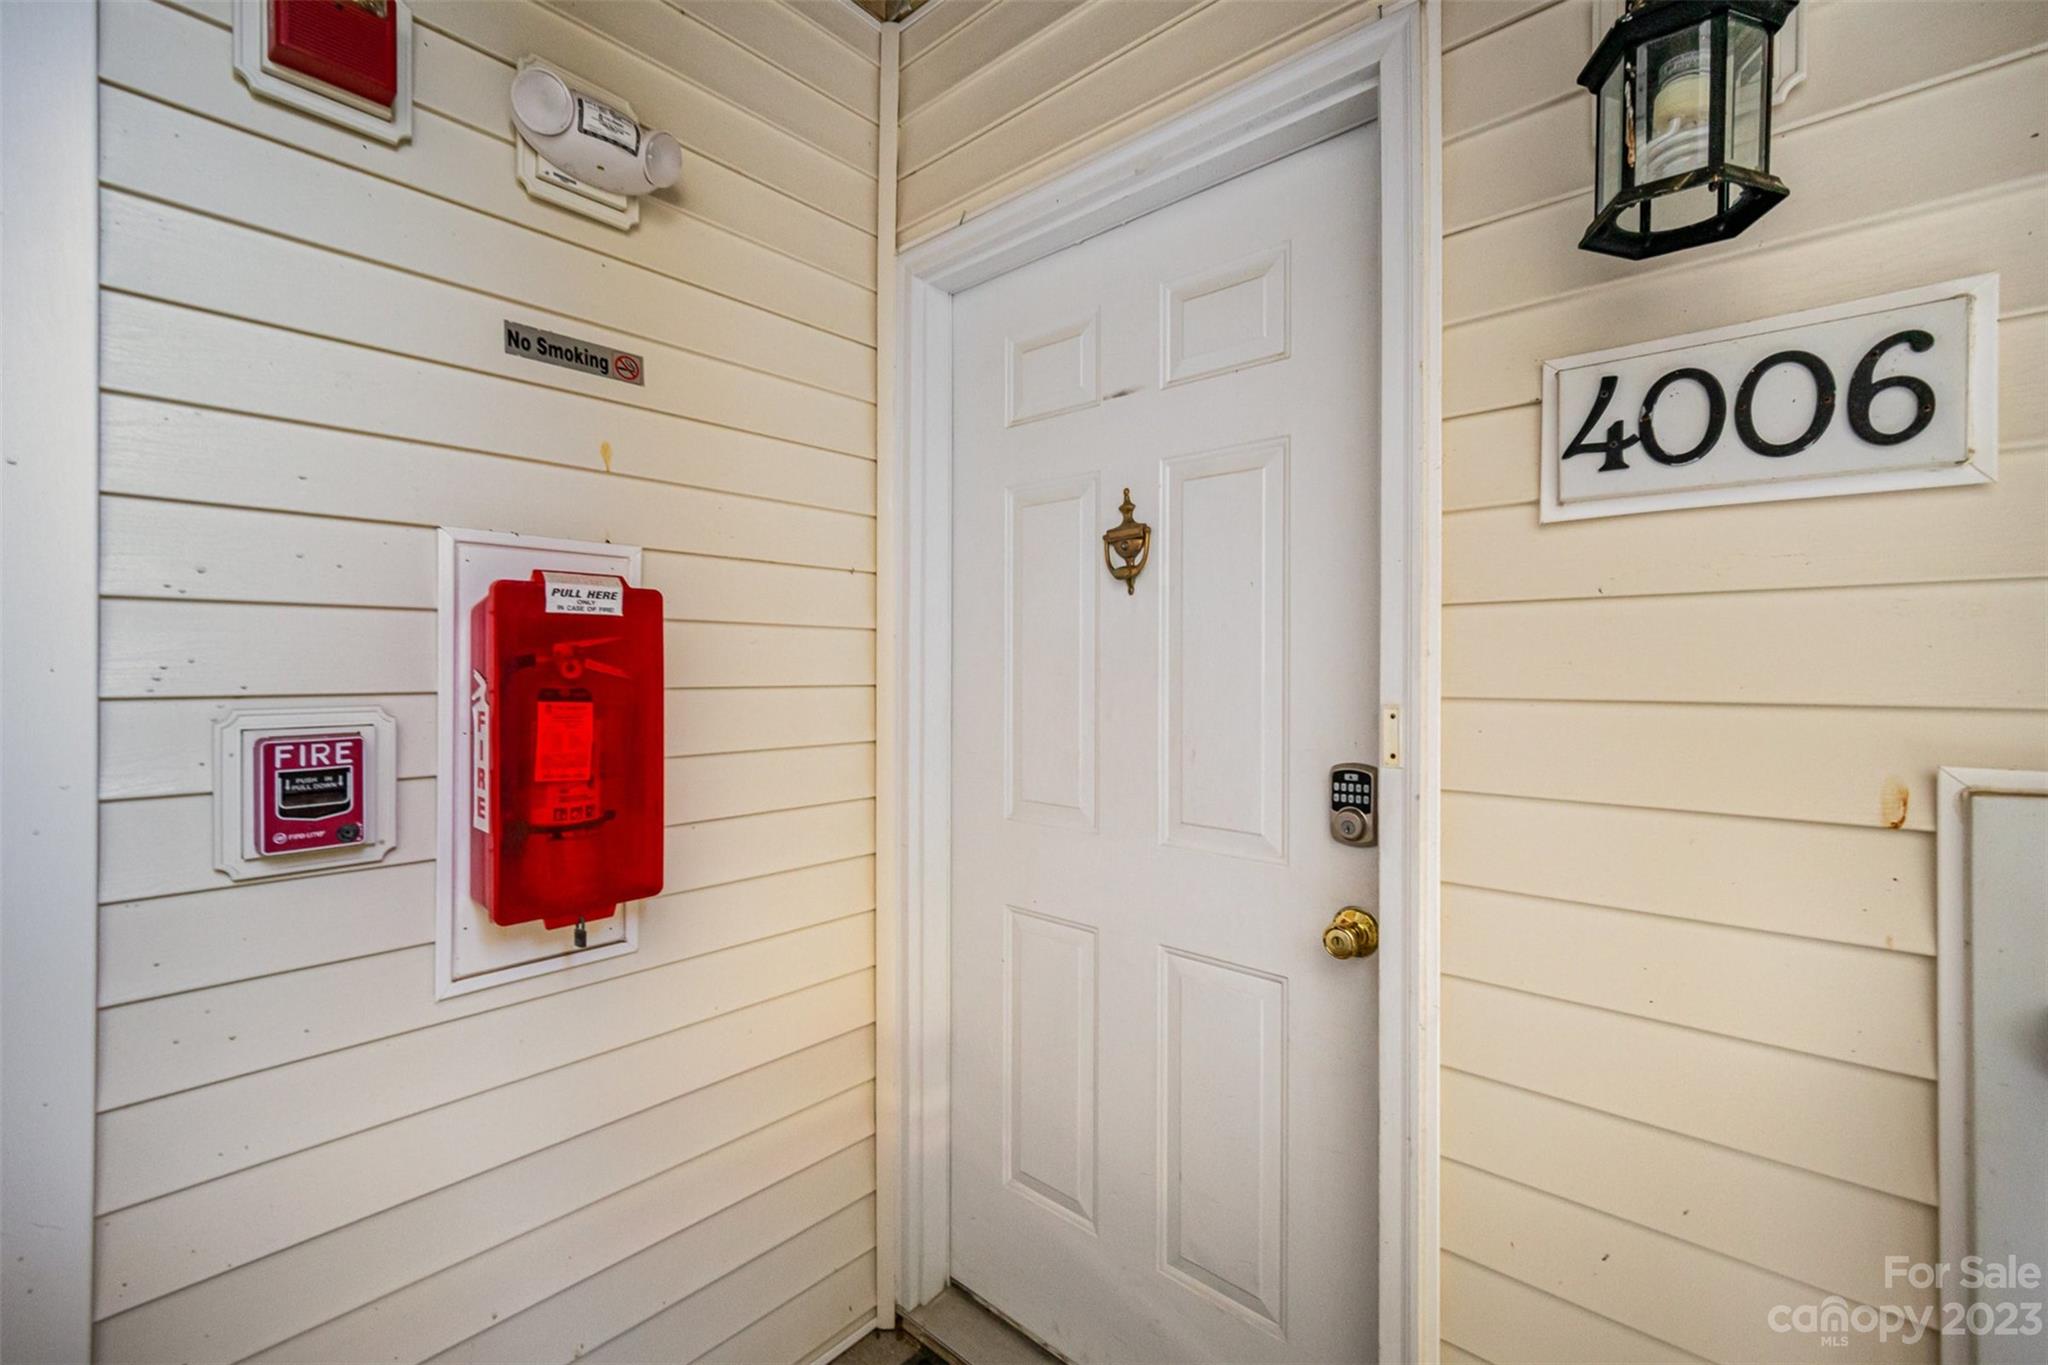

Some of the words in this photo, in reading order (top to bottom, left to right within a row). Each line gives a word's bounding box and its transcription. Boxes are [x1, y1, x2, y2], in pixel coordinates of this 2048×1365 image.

[507, 329, 531, 351] No
[537, 337, 609, 375] Smoking
[1562, 329, 1935, 473] 4006
[551, 588, 582, 598] PULL
[587, 590, 618, 600] HERE
[274, 742, 353, 768] FIRE
[477, 710, 486, 820] FIRE
[313, 782, 337, 790] DOWN
